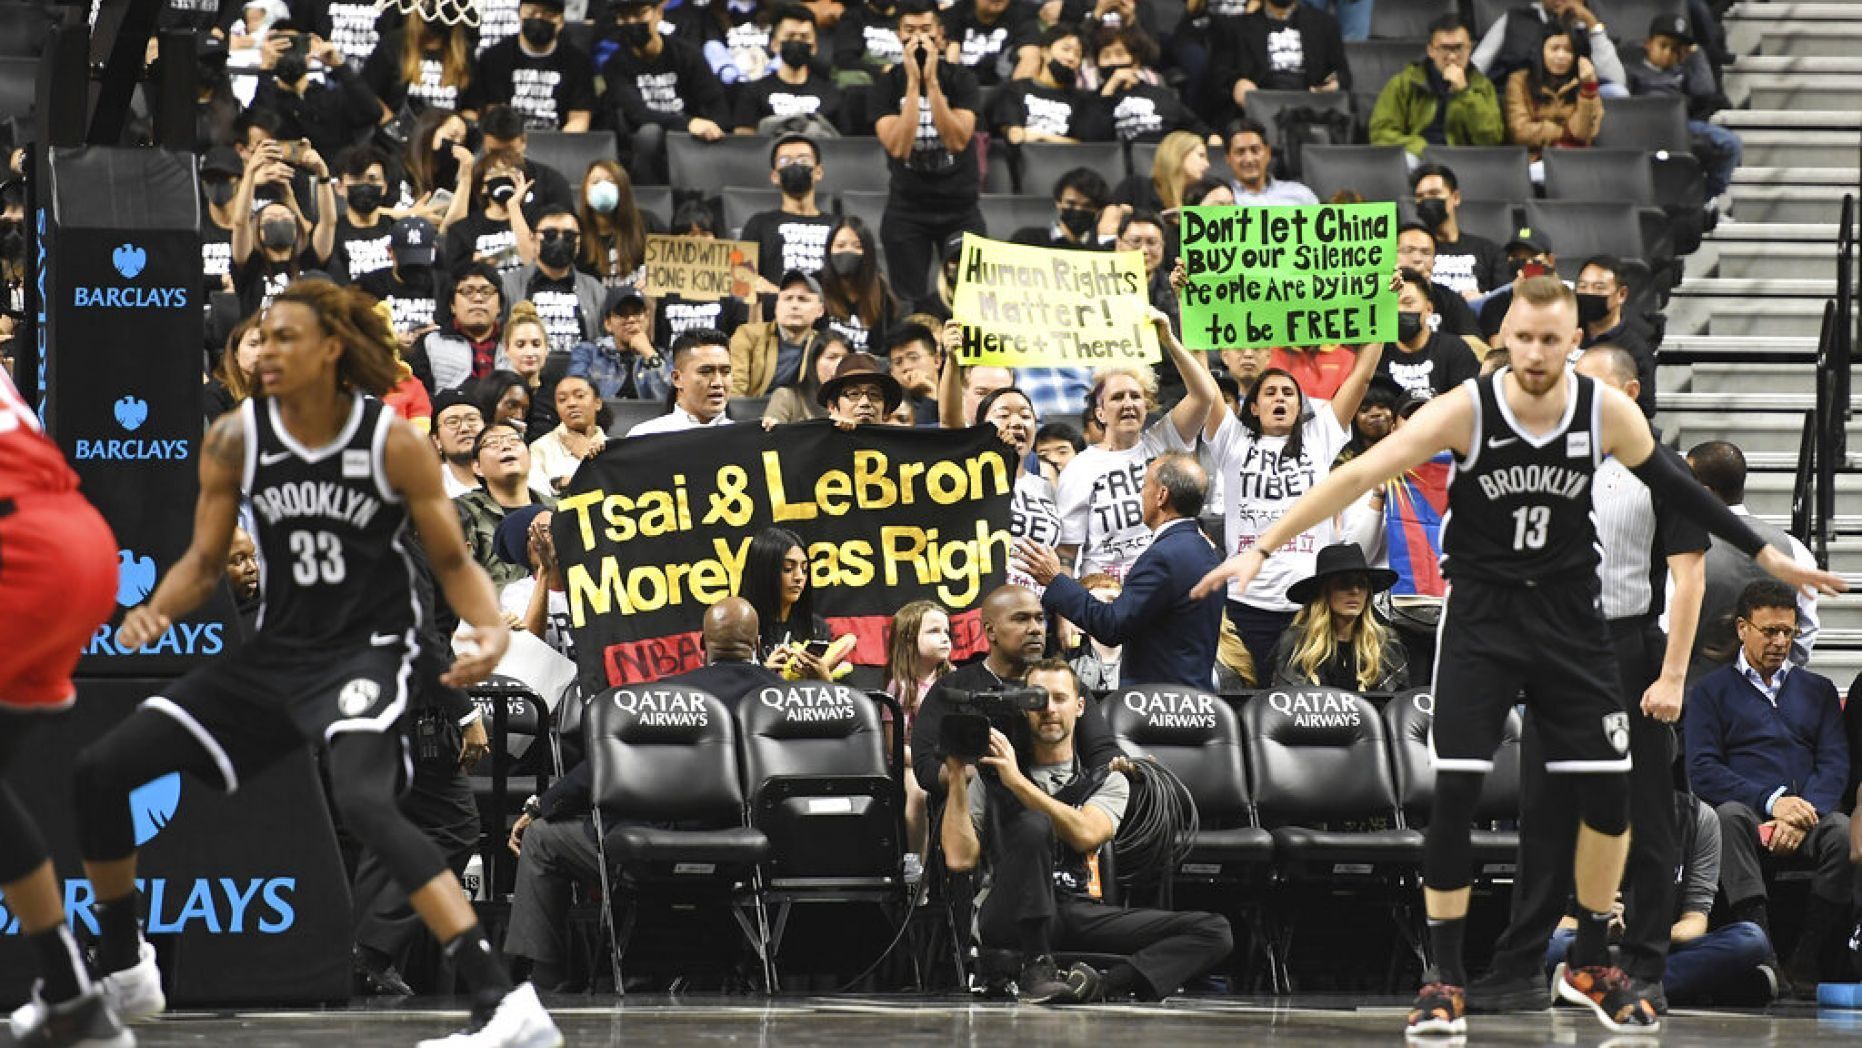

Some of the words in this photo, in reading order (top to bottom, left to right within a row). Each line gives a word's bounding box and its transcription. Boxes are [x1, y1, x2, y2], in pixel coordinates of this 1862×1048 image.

[1183, 208, 1252, 245] Don't
[1261, 209, 1308, 244] let
[1315, 207, 1389, 242] China
[648, 239, 699, 263] STAND
[699, 243, 731, 265] WITH
[1242, 246, 1285, 268] our
[1294, 244, 1383, 270] Silence
[646, 266, 685, 289] HONG
[692, 270, 732, 294] KONG
[965, 246, 1048, 290] Human
[1052, 257, 1137, 299] Rights
[1266, 277, 1307, 301] Are
[1313, 271, 1379, 301] Dying
[74, 288, 187, 307] BARCLAYS
[979, 291, 1114, 327] Matter!
[37, 207, 47, 437] ARCLAYS
[1205, 313, 1237, 344] to
[1247, 311, 1274, 342] be
[962, 326, 1028, 358] Here
[1051, 323, 1145, 358] There!
[75, 439, 189, 460] BARCLAYS
[1242, 446, 1314, 475] FREE
[1089, 456, 1157, 504] FRE
[1239, 469, 1316, 499] TIBET
[1477, 465, 1589, 500] BROOKLYN
[253, 480, 380, 529] BROOKLYN
[557, 474, 694, 552] Tsai
[701, 464, 755, 527] &
[761, 449, 1011, 523] LeBron
[1094, 499, 1143, 534] TIB
[1512, 505, 1551, 550] 13
[289, 530, 347, 586] 33
[807, 539, 876, 589] as
[880, 519, 1013, 608] Righ
[612, 635, 702, 683] NBA
[614, 689, 708, 715] QATAR
[760, 685, 853, 712] QATAR
[786, 705, 855, 722] AIRWAYS
[1124, 692, 1216, 716] QATAR
[1268, 692, 1359, 716] QATAR
[639, 712, 708, 727] AIRWAYS
[1149, 712, 1216, 728] AIRWAYS
[1294, 712, 1361, 728] AIRWAYS
